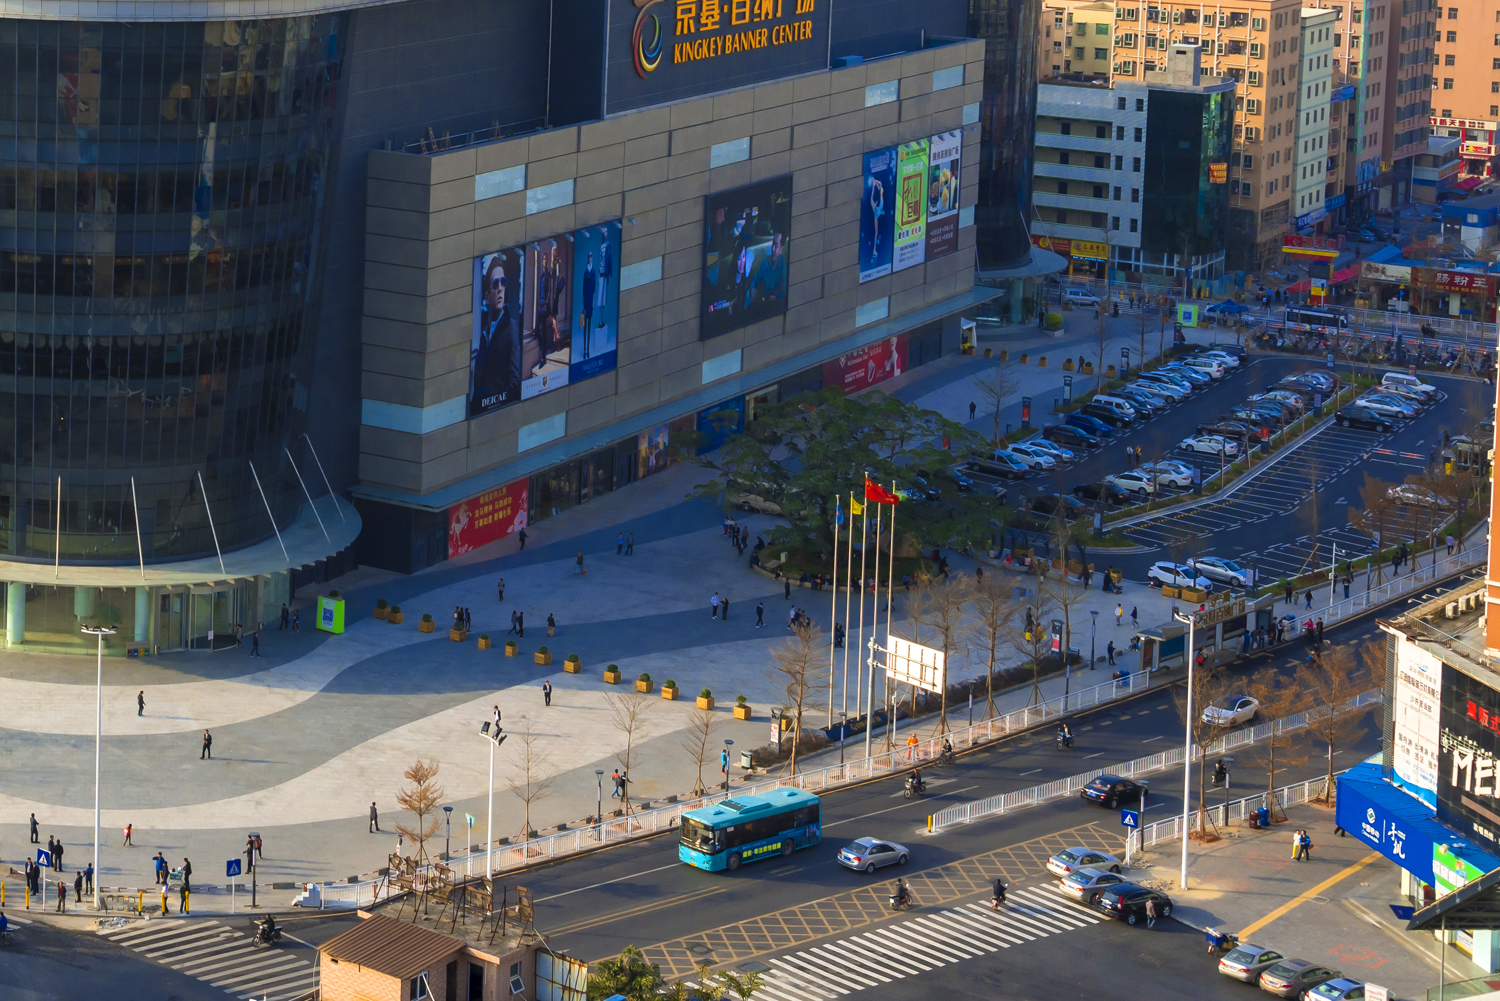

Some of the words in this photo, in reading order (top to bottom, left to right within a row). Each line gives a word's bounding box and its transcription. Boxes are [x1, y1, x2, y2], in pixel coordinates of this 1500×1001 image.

[674, 36, 724, 64] KINGKEY
[725, 28, 768, 54] BANNER
[772, 20, 812, 46] CENTER
[1436, 272, 1488, 288] 肠粉王
[481, 391, 508, 408] DEICAE
